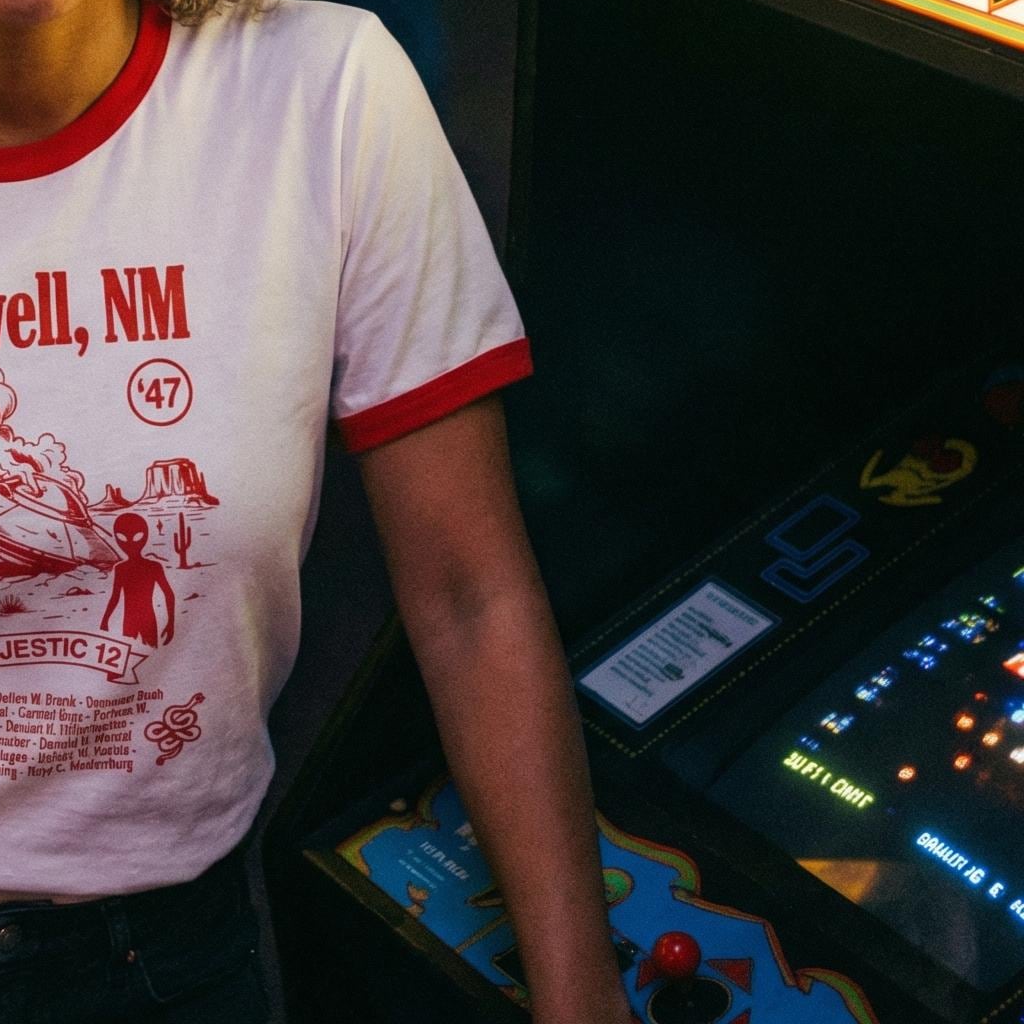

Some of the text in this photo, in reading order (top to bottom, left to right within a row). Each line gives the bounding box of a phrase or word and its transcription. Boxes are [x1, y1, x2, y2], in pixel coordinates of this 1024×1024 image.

[101, 265, 191, 343] NM
[137, 377, 181, 409] '47
[95, 643, 122, 668] 12
